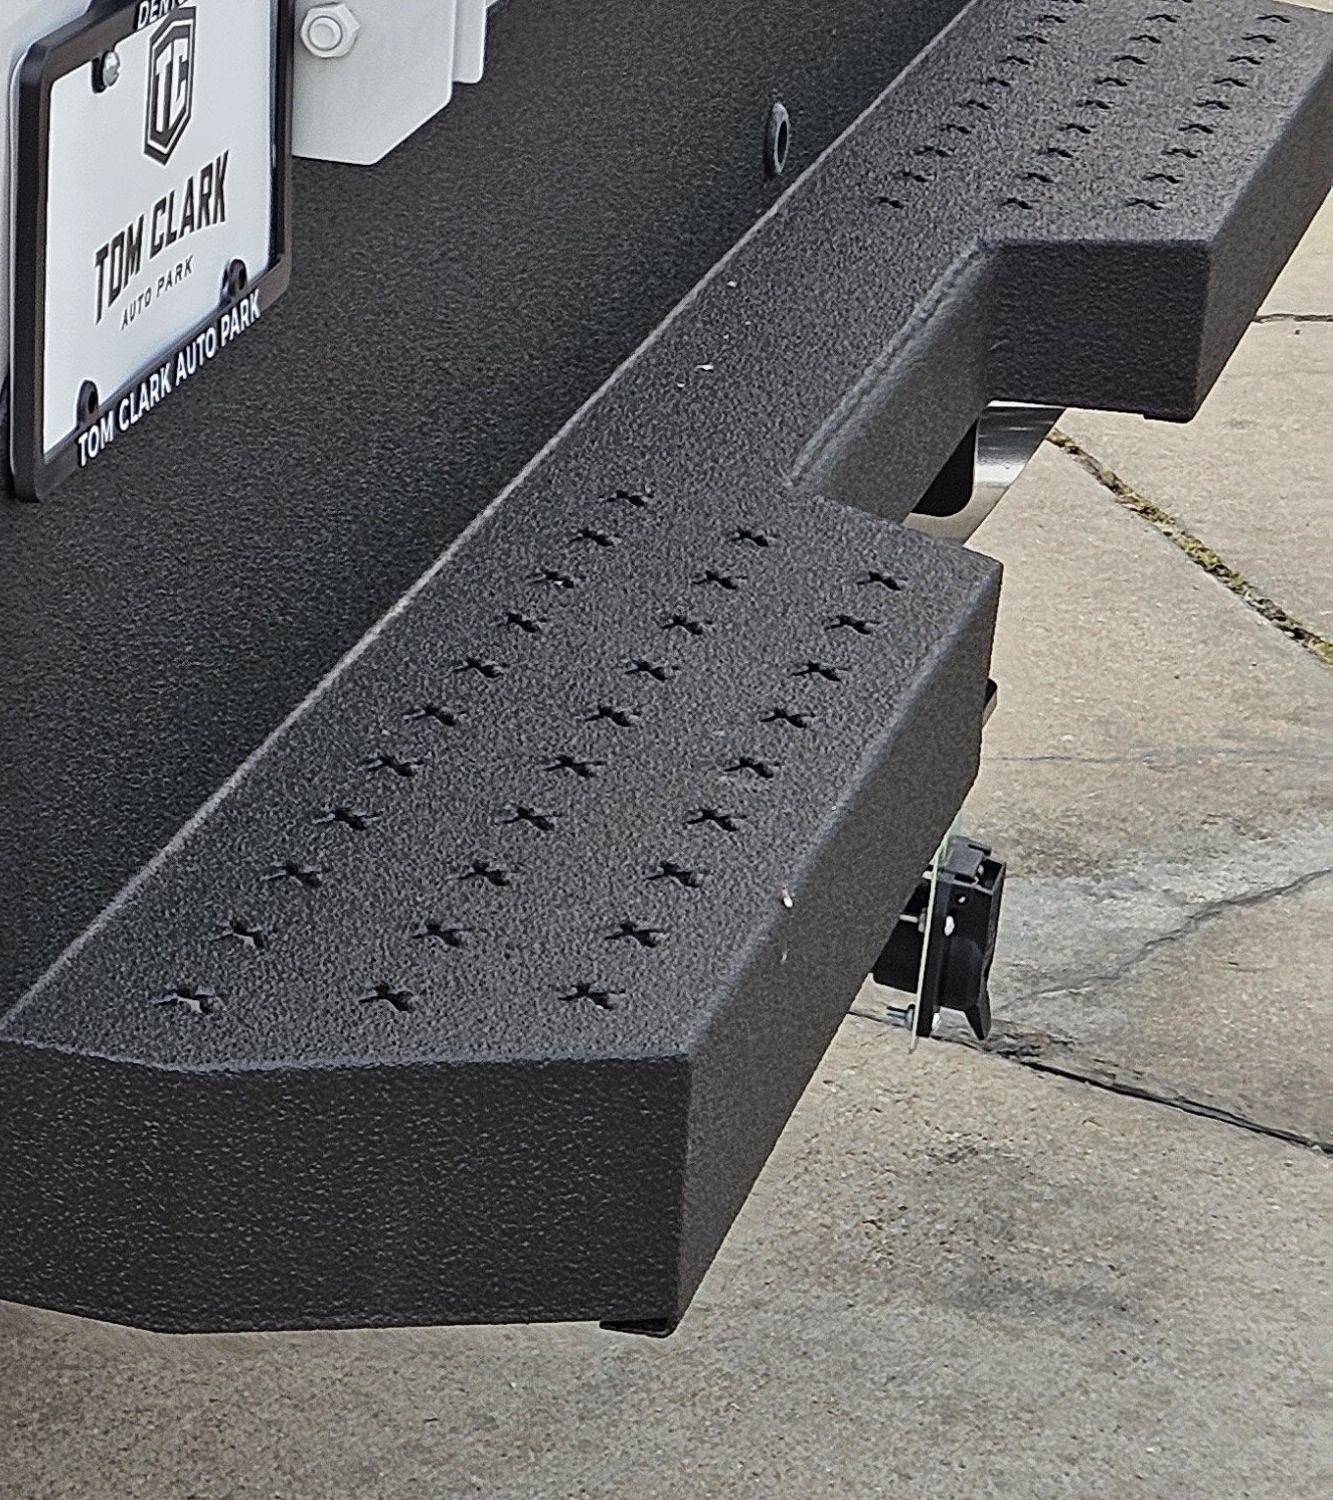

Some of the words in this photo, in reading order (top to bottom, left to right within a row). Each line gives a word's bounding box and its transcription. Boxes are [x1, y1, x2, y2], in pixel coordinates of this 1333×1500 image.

[94, 212, 146, 326] TOM
[148, 148, 230, 261] CLARK
[120, 285, 152, 331] AUTO
[156, 254, 195, 299] PARK
[77, 414, 115, 468] TOM
[118, 361, 172, 433] CLARK
[175, 325, 217, 388] AUTO
[220, 287, 261, 347] PARK
